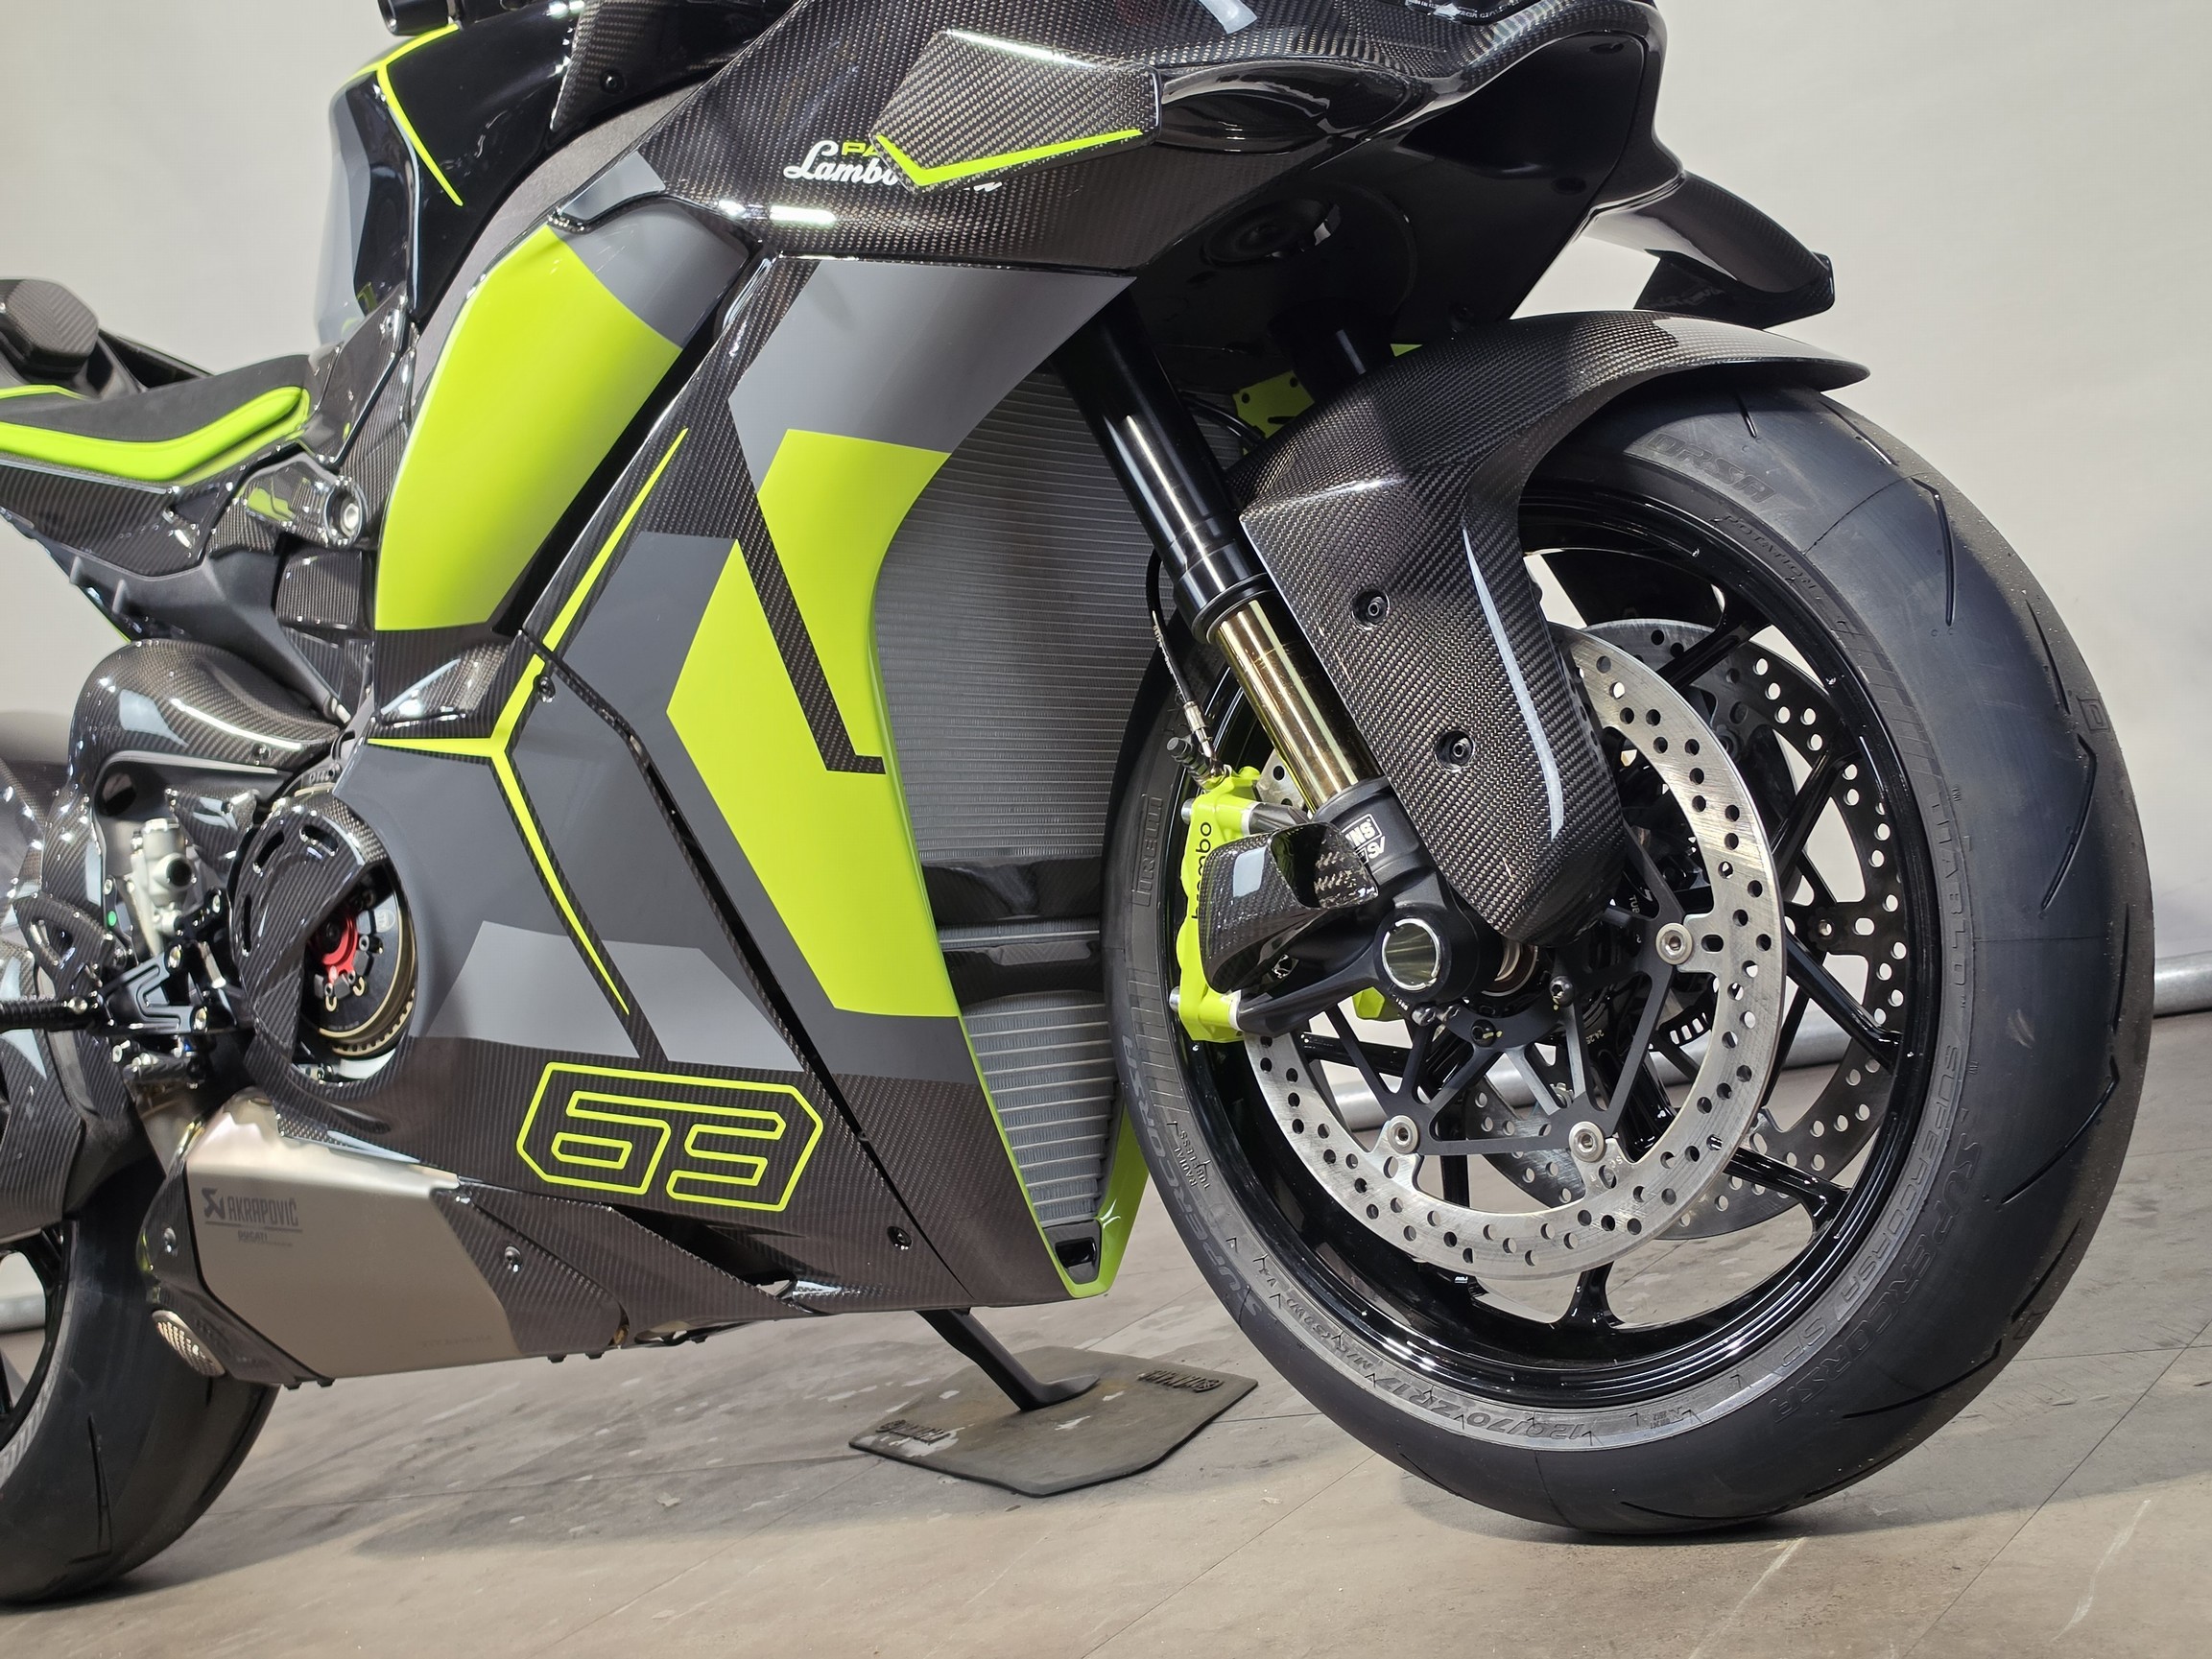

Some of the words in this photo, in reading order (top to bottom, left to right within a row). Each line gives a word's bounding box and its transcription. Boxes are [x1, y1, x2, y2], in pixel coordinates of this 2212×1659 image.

[1131, 793, 1165, 907] PIRELLI
[516, 1061, 823, 1212] 63
[1838, 1043, 1958, 1303] SUPERCORSA
[1768, 1130, 1983, 1424] SUPERCORSA
[1780, 1315, 1829, 1367] SP
